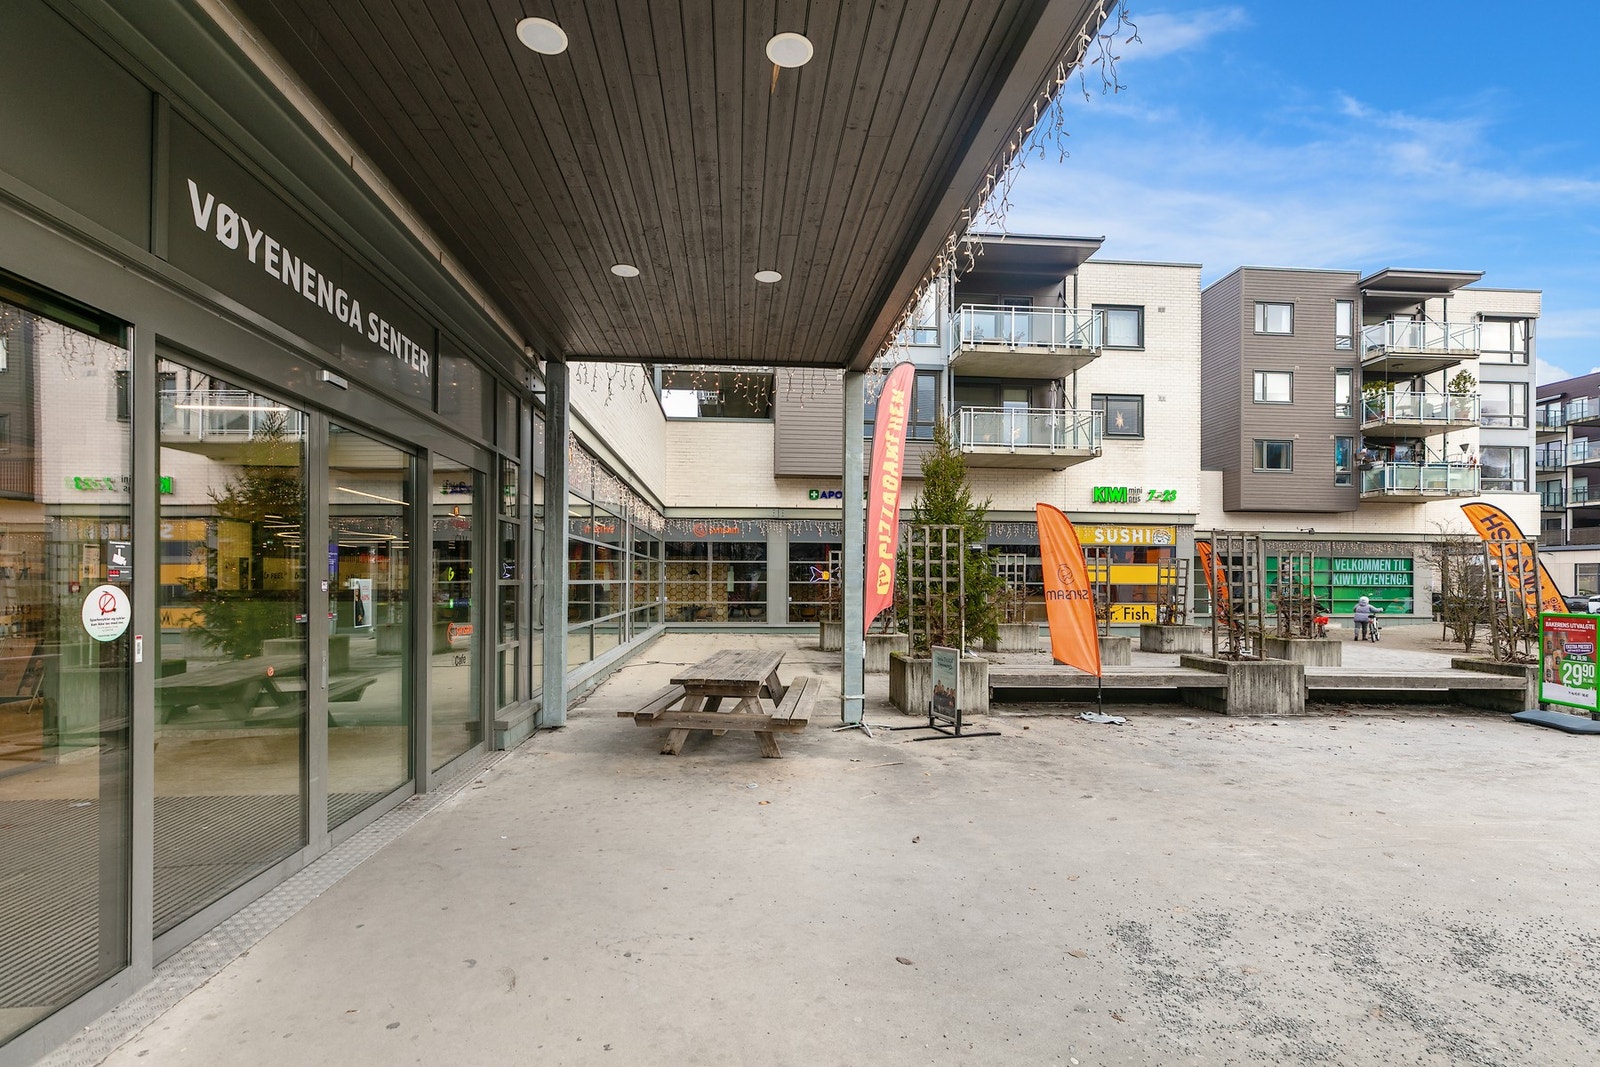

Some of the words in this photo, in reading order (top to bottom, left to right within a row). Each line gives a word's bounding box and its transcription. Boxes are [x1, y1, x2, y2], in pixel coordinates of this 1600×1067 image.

[187, 178, 364, 335] VØYENENGA
[368, 311, 431, 378] SENTER
[820, 490, 843, 499] APO
[1092, 486, 1128, 503] KIWI
[1094, 529, 1152, 543] SUSHI
[1335, 559, 1391, 571] VELKOMMEN
[1393, 559, 1407, 571] TIL
[1333, 573, 1354, 585] KIWI
[1356, 573, 1408, 585] VØYENENGA
